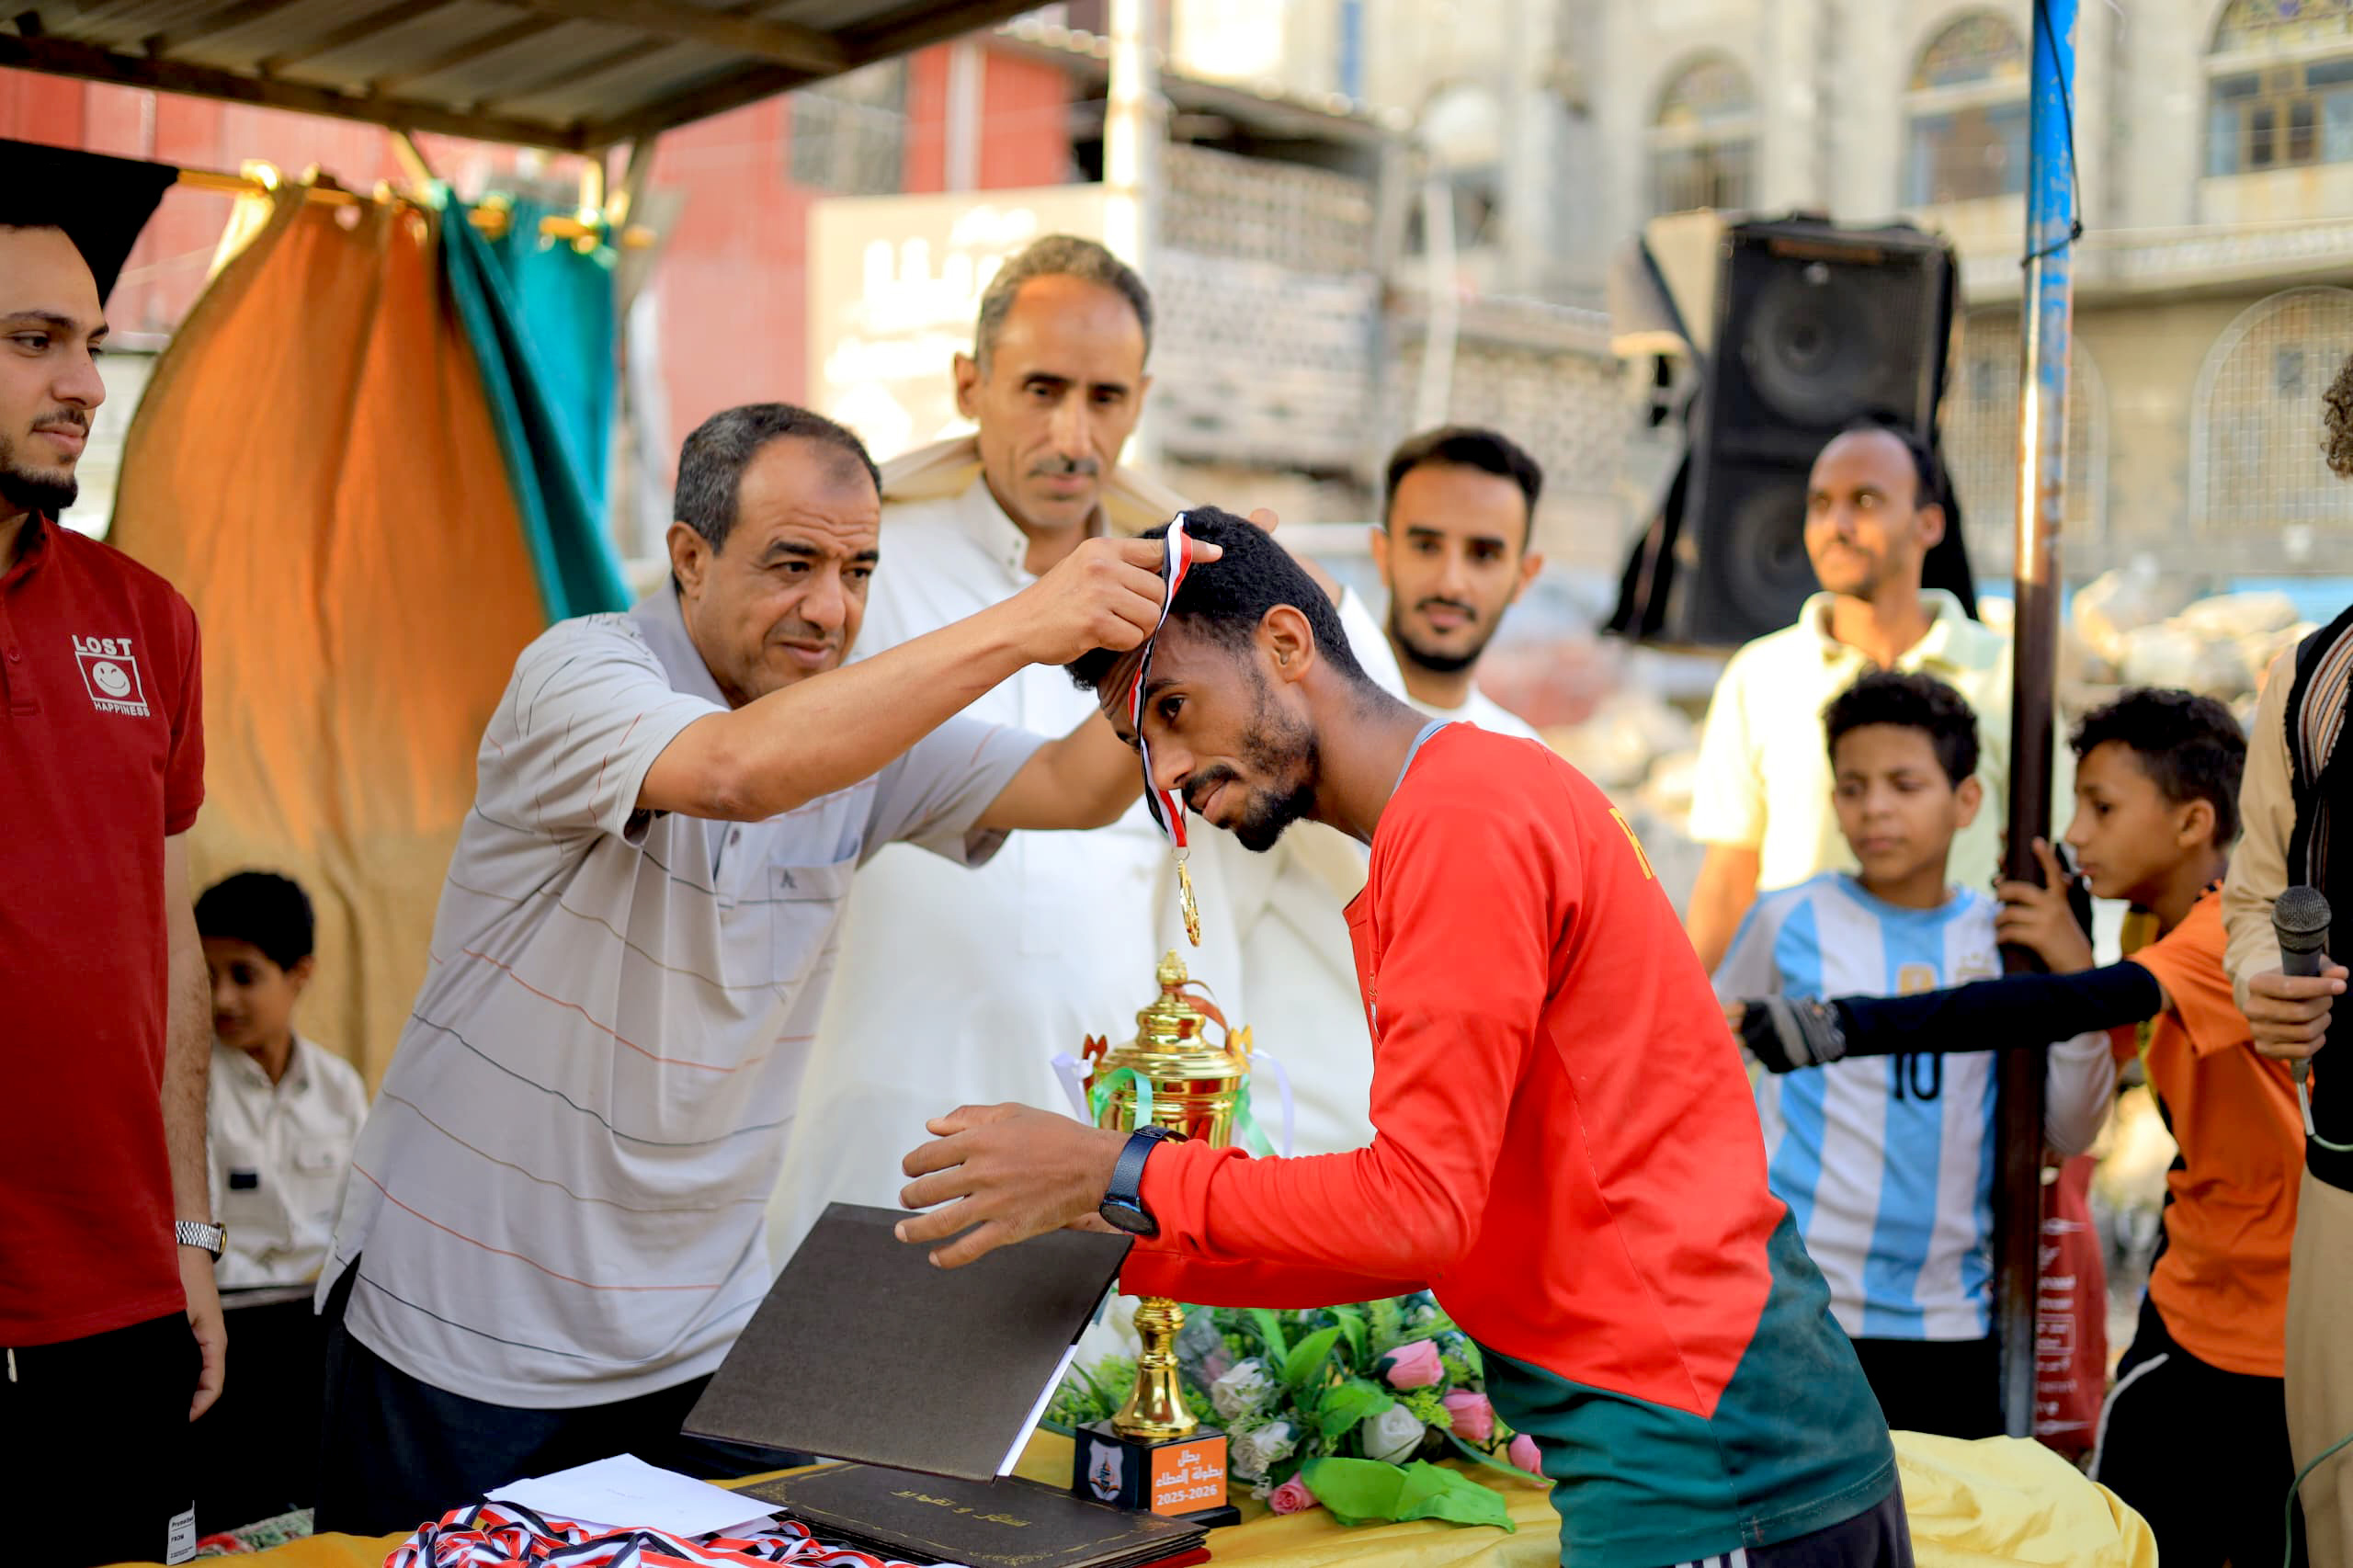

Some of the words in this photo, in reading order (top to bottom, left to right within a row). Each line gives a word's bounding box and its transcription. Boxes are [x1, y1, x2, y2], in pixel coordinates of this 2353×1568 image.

[72, 634, 132, 656] LOST
[94, 701, 151, 718] HAPPINESS
[1176, 1449, 1201, 1467] بطل
[1191, 1464, 1223, 1481] بطولة
[1156, 1484, 1218, 1506] 2025-2026
